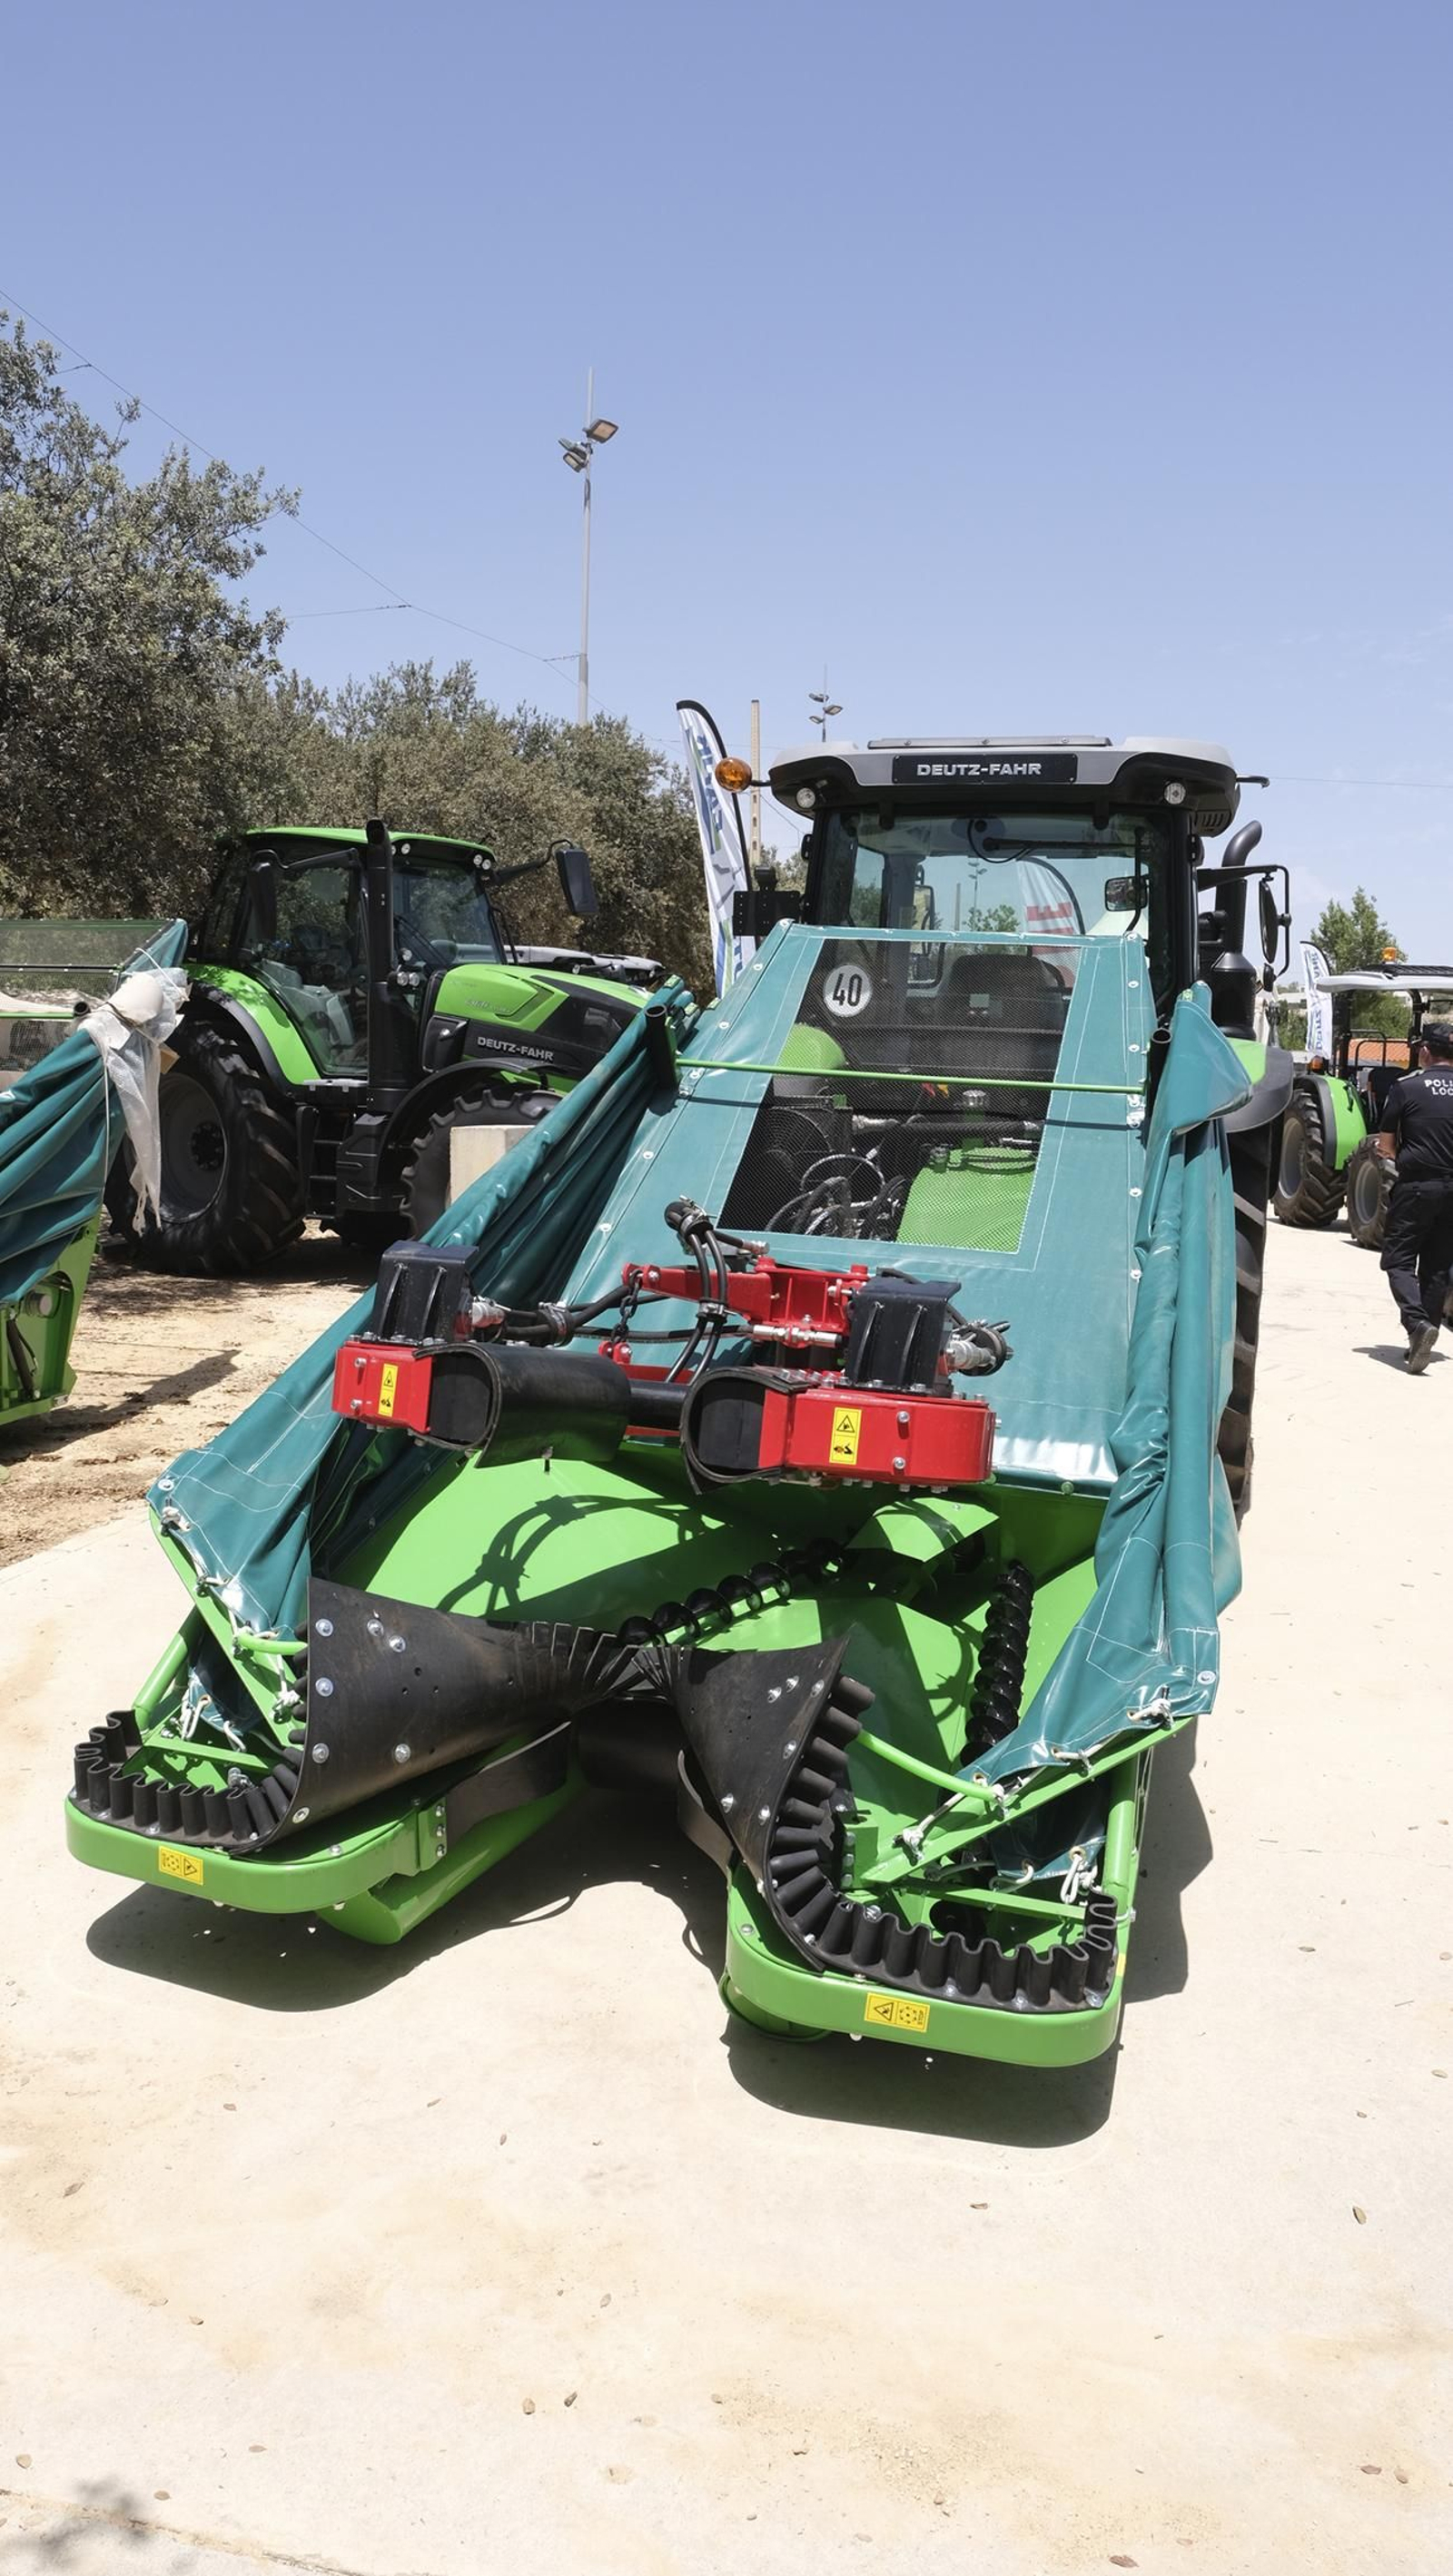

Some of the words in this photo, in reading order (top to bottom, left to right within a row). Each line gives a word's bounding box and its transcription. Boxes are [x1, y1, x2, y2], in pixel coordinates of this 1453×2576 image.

[916, 764, 1043, 776] DEUTZ-FAHR
[832, 972, 863, 1007] 40
[477, 1036, 554, 1061] DEUTZ-FAHR
